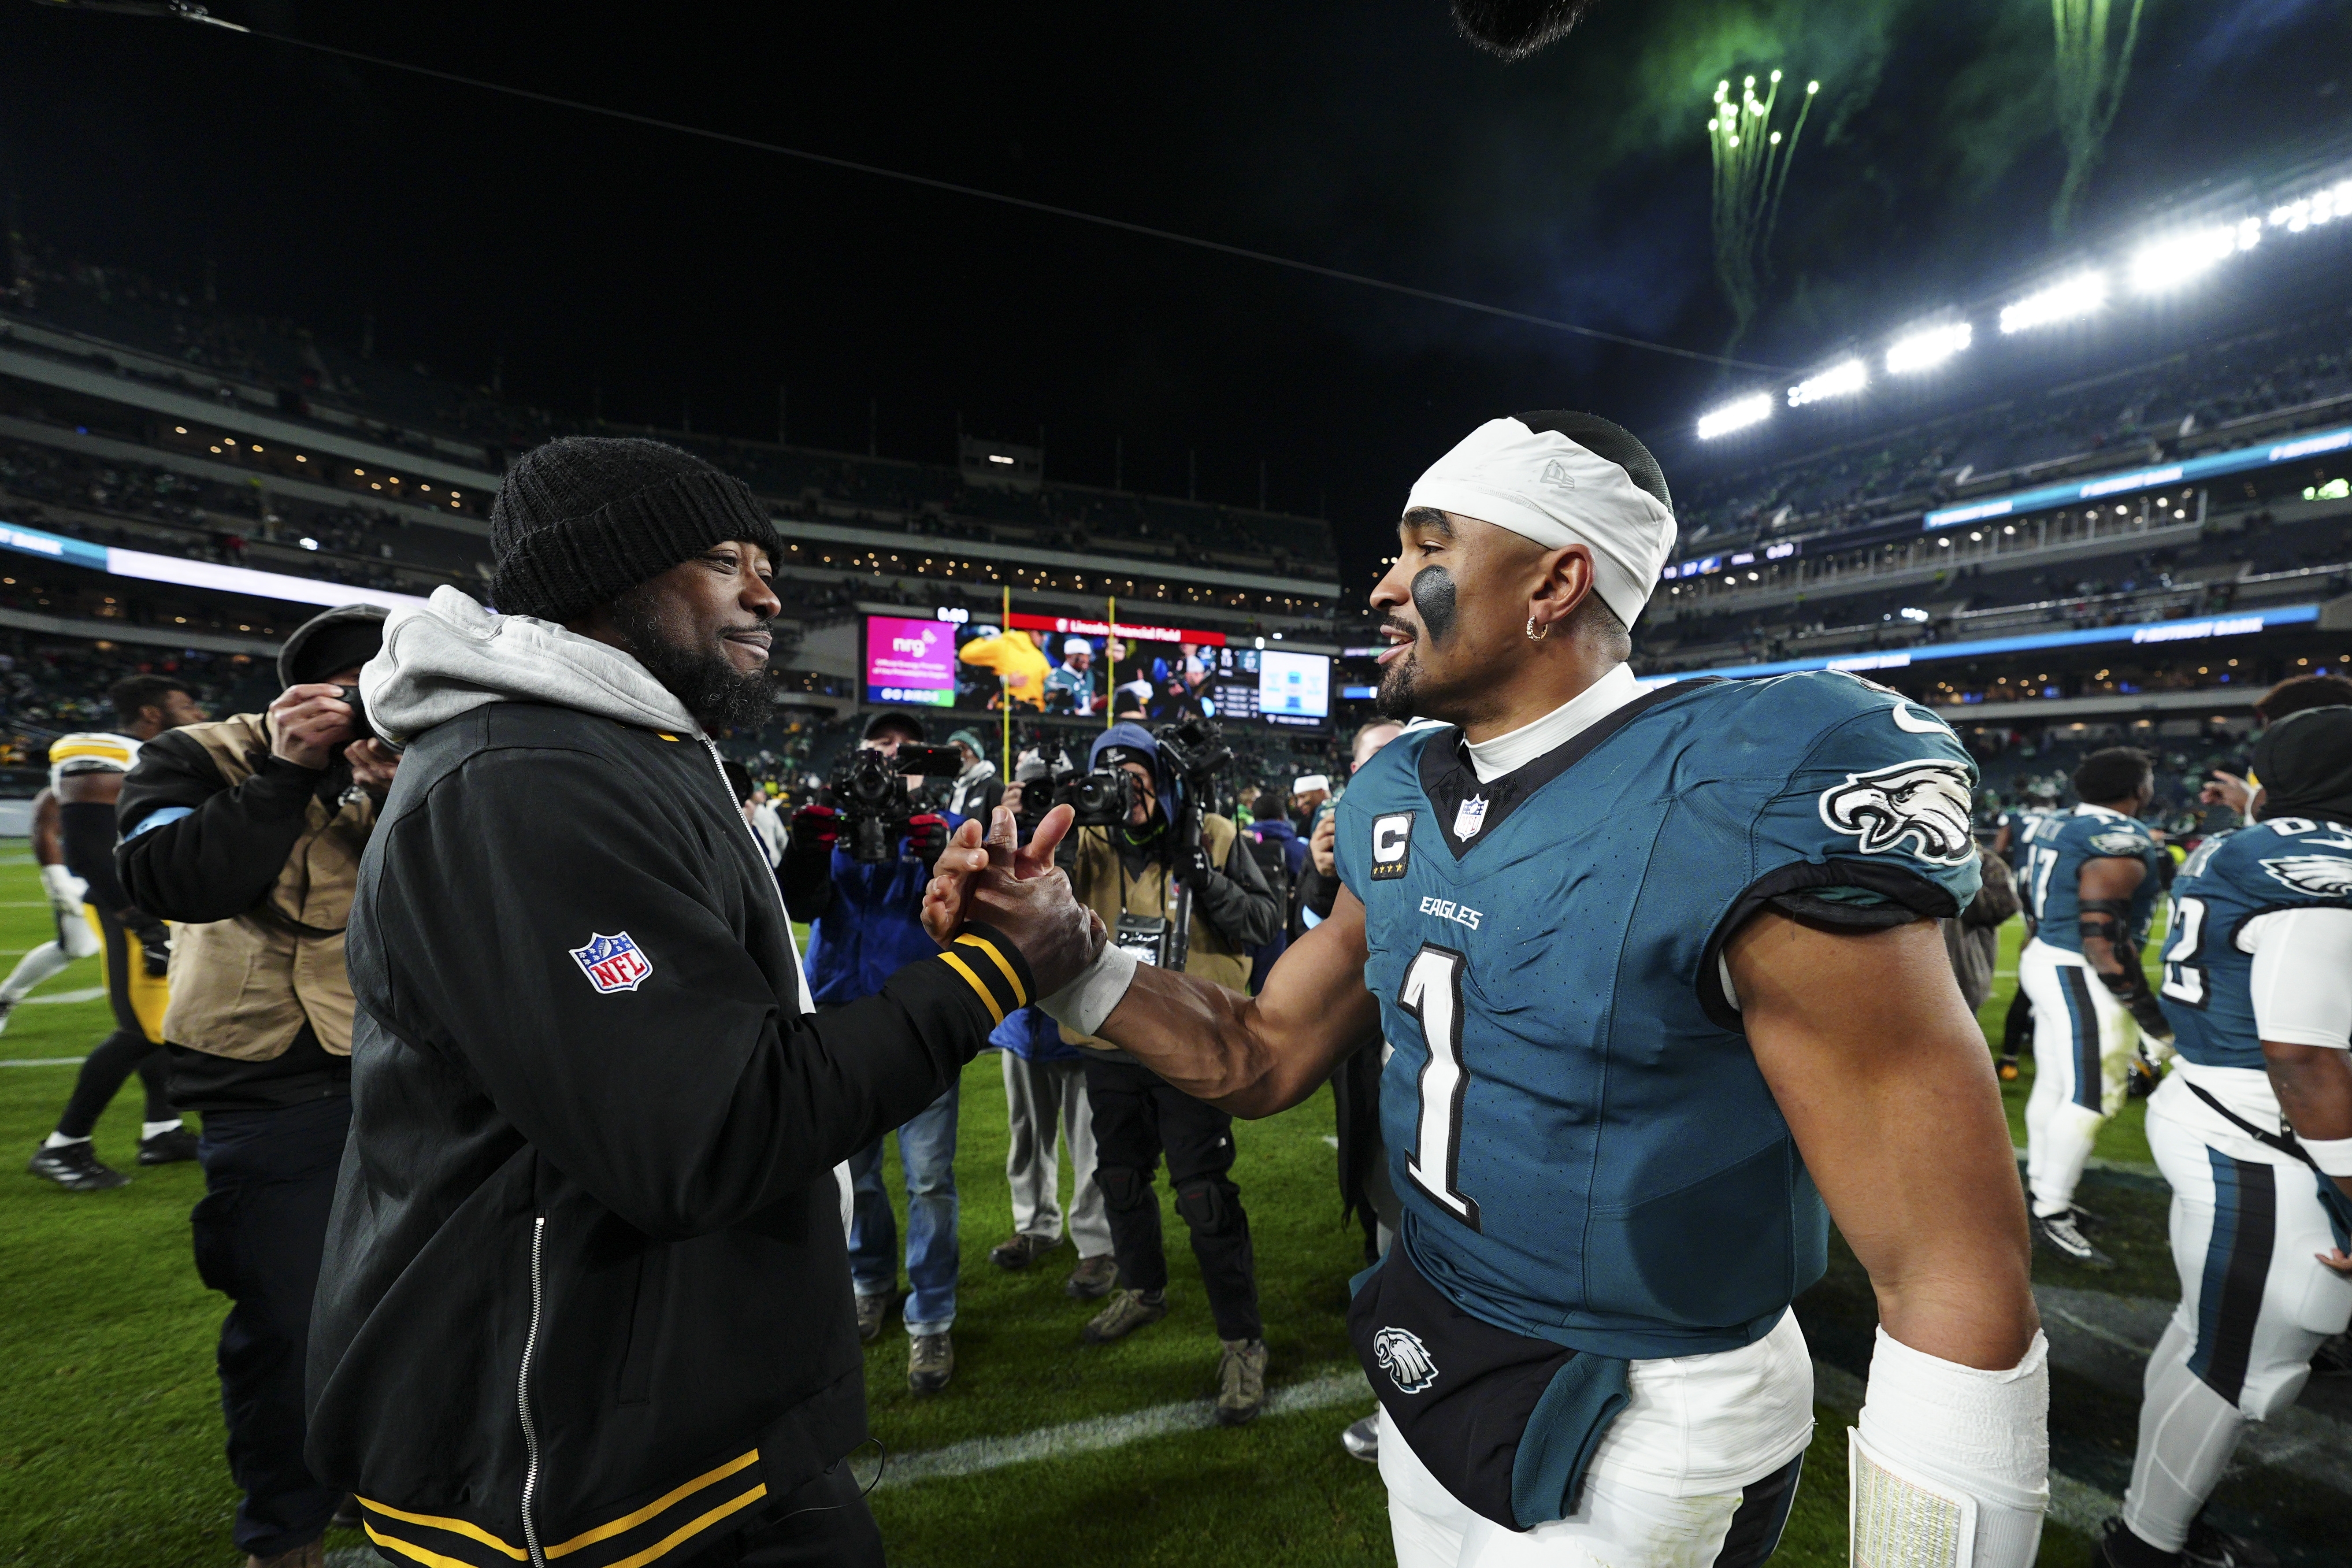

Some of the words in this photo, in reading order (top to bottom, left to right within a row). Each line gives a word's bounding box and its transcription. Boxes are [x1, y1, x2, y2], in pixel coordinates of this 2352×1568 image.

[1070, 619, 1110, 636] Lincoln
[1110, 623, 1155, 640] Financial
[1155, 628, 1181, 642] Field
[892, 637, 926, 658] nrg
[881, 687, 903, 701] GO
[1458, 814, 1480, 834] NFL
[1373, 816, 1408, 863] C
[1419, 896, 1484, 930] EAGLES
[2162, 896, 2206, 1004] 2
[590, 952, 646, 987] NFL
[1399, 944, 1477, 1230] 1
[1892, 1499, 1898, 1508] LT
[1910, 1511, 1917, 1520] LT
[1917, 1514, 1923, 1523] RT
[1924, 1513, 1930, 1522] RT
[1931, 1516, 1937, 1525] RT
[1937, 1518, 1944, 1527] RT
